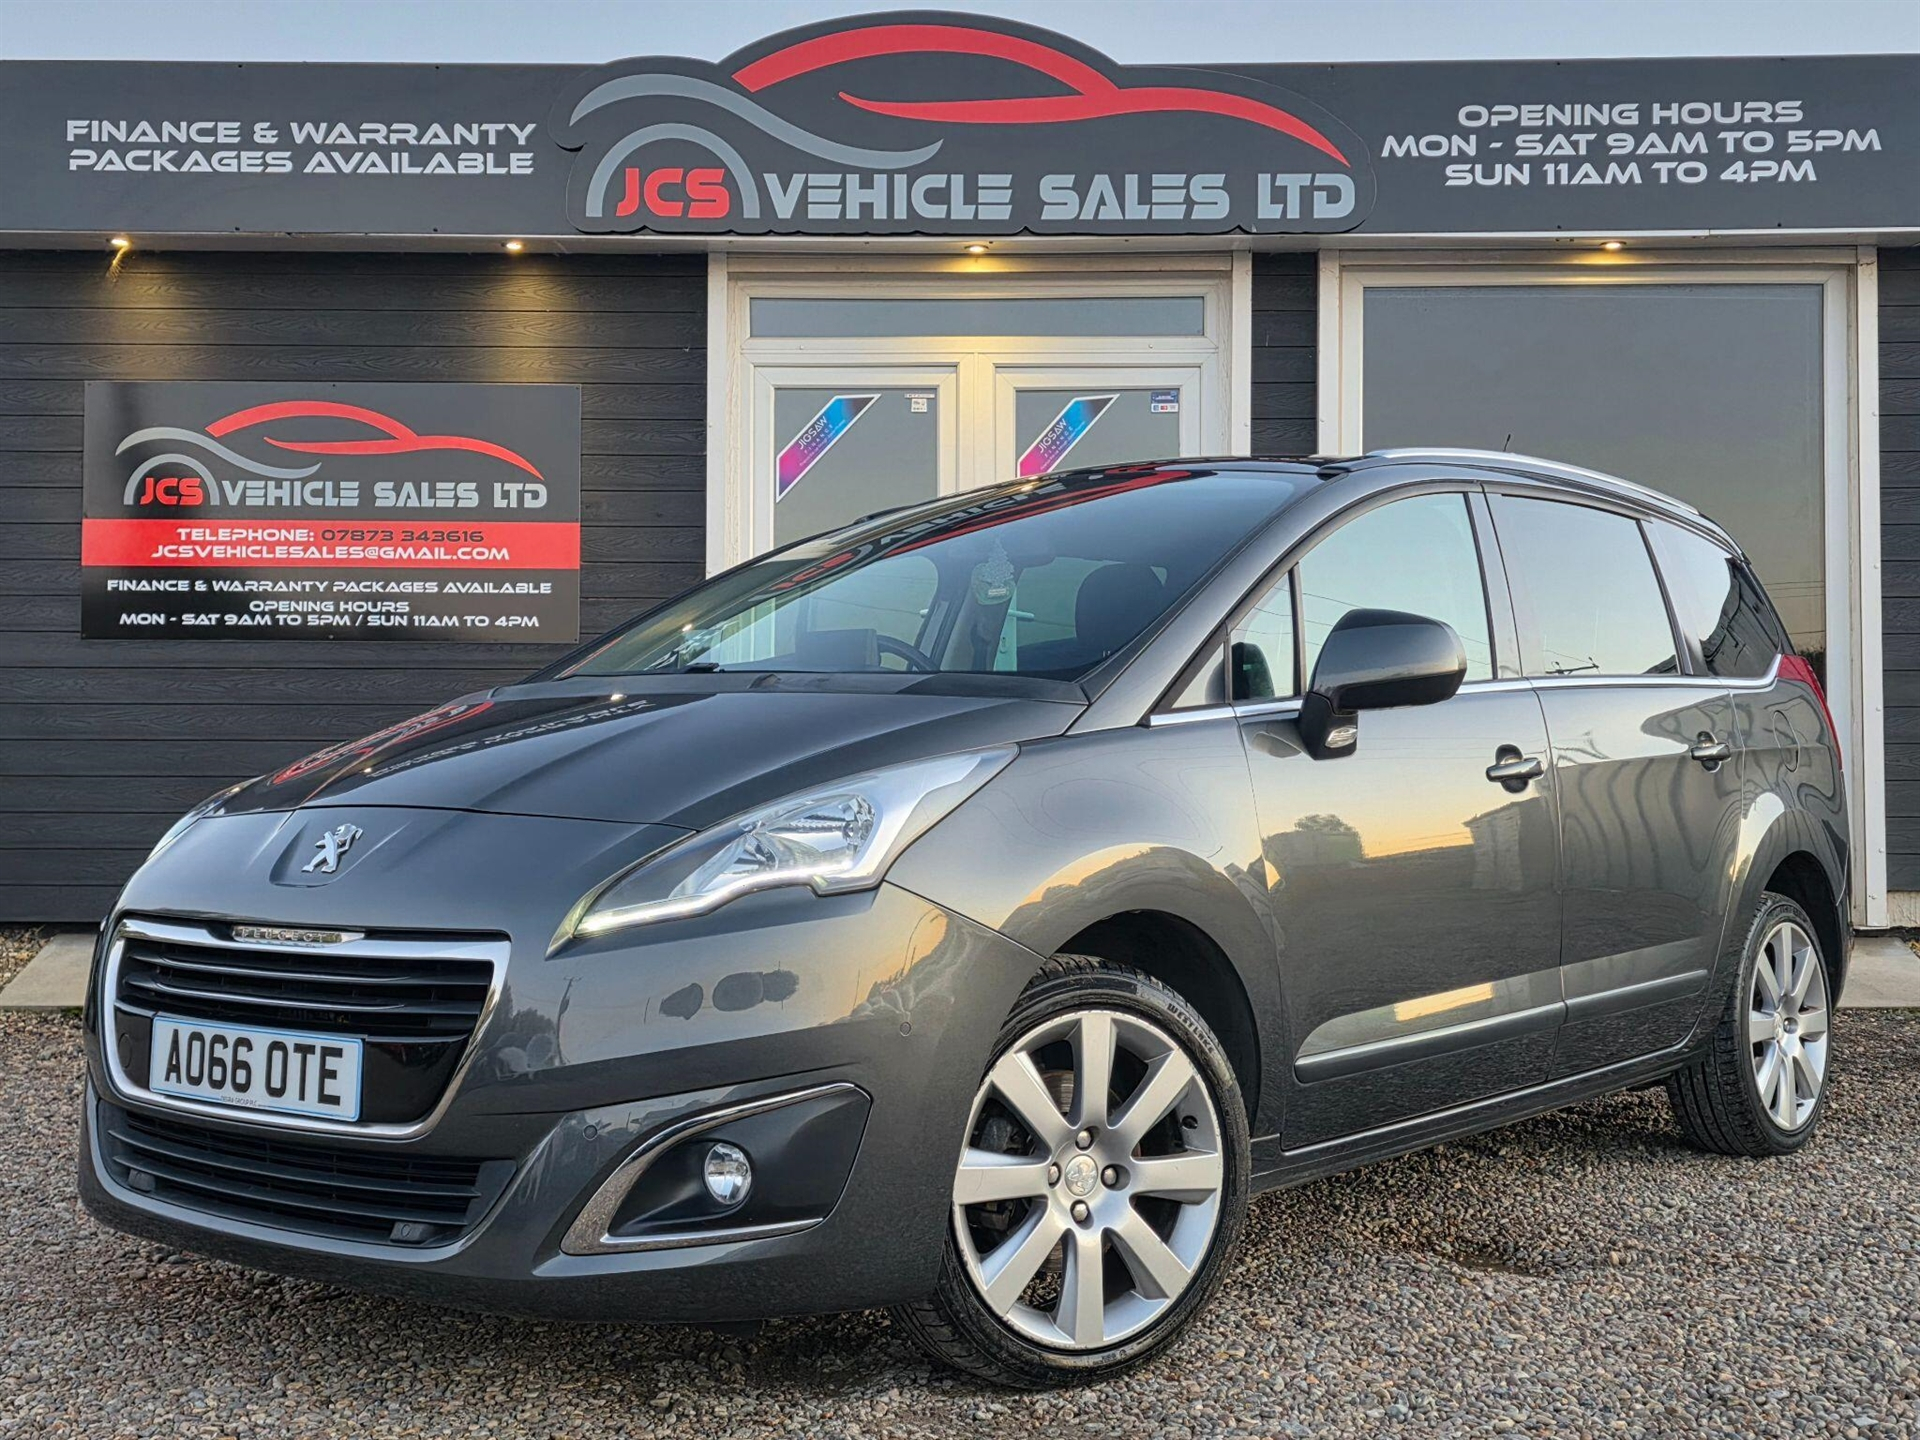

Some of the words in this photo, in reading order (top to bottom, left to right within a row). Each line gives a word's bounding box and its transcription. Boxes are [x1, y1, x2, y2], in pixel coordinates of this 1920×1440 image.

[1458, 103, 1639, 128] OPENING
[1652, 100, 1804, 125] HOURS
[66, 119, 241, 144] FINANCE
[253, 122, 279, 144] &
[289, 121, 537, 146] WARRANTY
[1381, 133, 1477, 158] MON
[1514, 132, 1598, 156] SAT
[1606, 131, 1709, 155] 9AM
[1717, 130, 1775, 154] TO
[1787, 128, 1882, 153] 5PM
[69, 148, 293, 174] PACKAGES
[302, 150, 535, 175] AVAILABLE
[1444, 162, 1530, 187] SUN
[1542, 161, 1643, 185] 11AM
[1650, 160, 1708, 184] TO
[1719, 159, 1817, 183] 4PM
[615, 167, 730, 219] JCS
[764, 172, 1013, 220] VEHICLE
[1039, 173, 1230, 221] SALES
[1257, 173, 1356, 220] LTD
[798, 415, 828, 450] JIGSAW
[1038, 417, 1067, 453] JIGSAW
[140, 477, 203, 506] JCS
[221, 479, 360, 508] VEHICLE
[373, 481, 480, 508] SALES
[493, 481, 548, 509] LTD
[176, 527, 316, 542] TELEPHONE:
[321, 529, 395, 542] 07873
[401, 530, 485, 543] 343616
[151, 545, 510, 561] JCSVEHICLESALES@GMAIL.COM
[107, 579, 190, 592] FINANCE
[194, 580, 208, 592] &
[211, 580, 330, 593] WARRANTY
[332, 580, 440, 594] PACKAGES
[442, 581, 553, 595] AVAILABLE
[119, 613, 165, 625] MON
[181, 613, 225, 626] SAT
[224, 613, 272, 626] 9AM
[274, 614, 303, 626] TO
[306, 614, 352, 626] 5PM
[355, 614, 363, 627] /
[366, 614, 408, 627] SUN
[412, 614, 460, 627] 11AM
[462, 615, 490, 628] TO
[494, 615, 540, 628] 4PM
[249, 600, 335, 613] OPENING
[339, 600, 411, 613] HOURS
[1166, 1003, 1216, 1053] WESTLAKE
[164, 1028, 253, 1094] AO66
[265, 1040, 343, 1106] OTE
